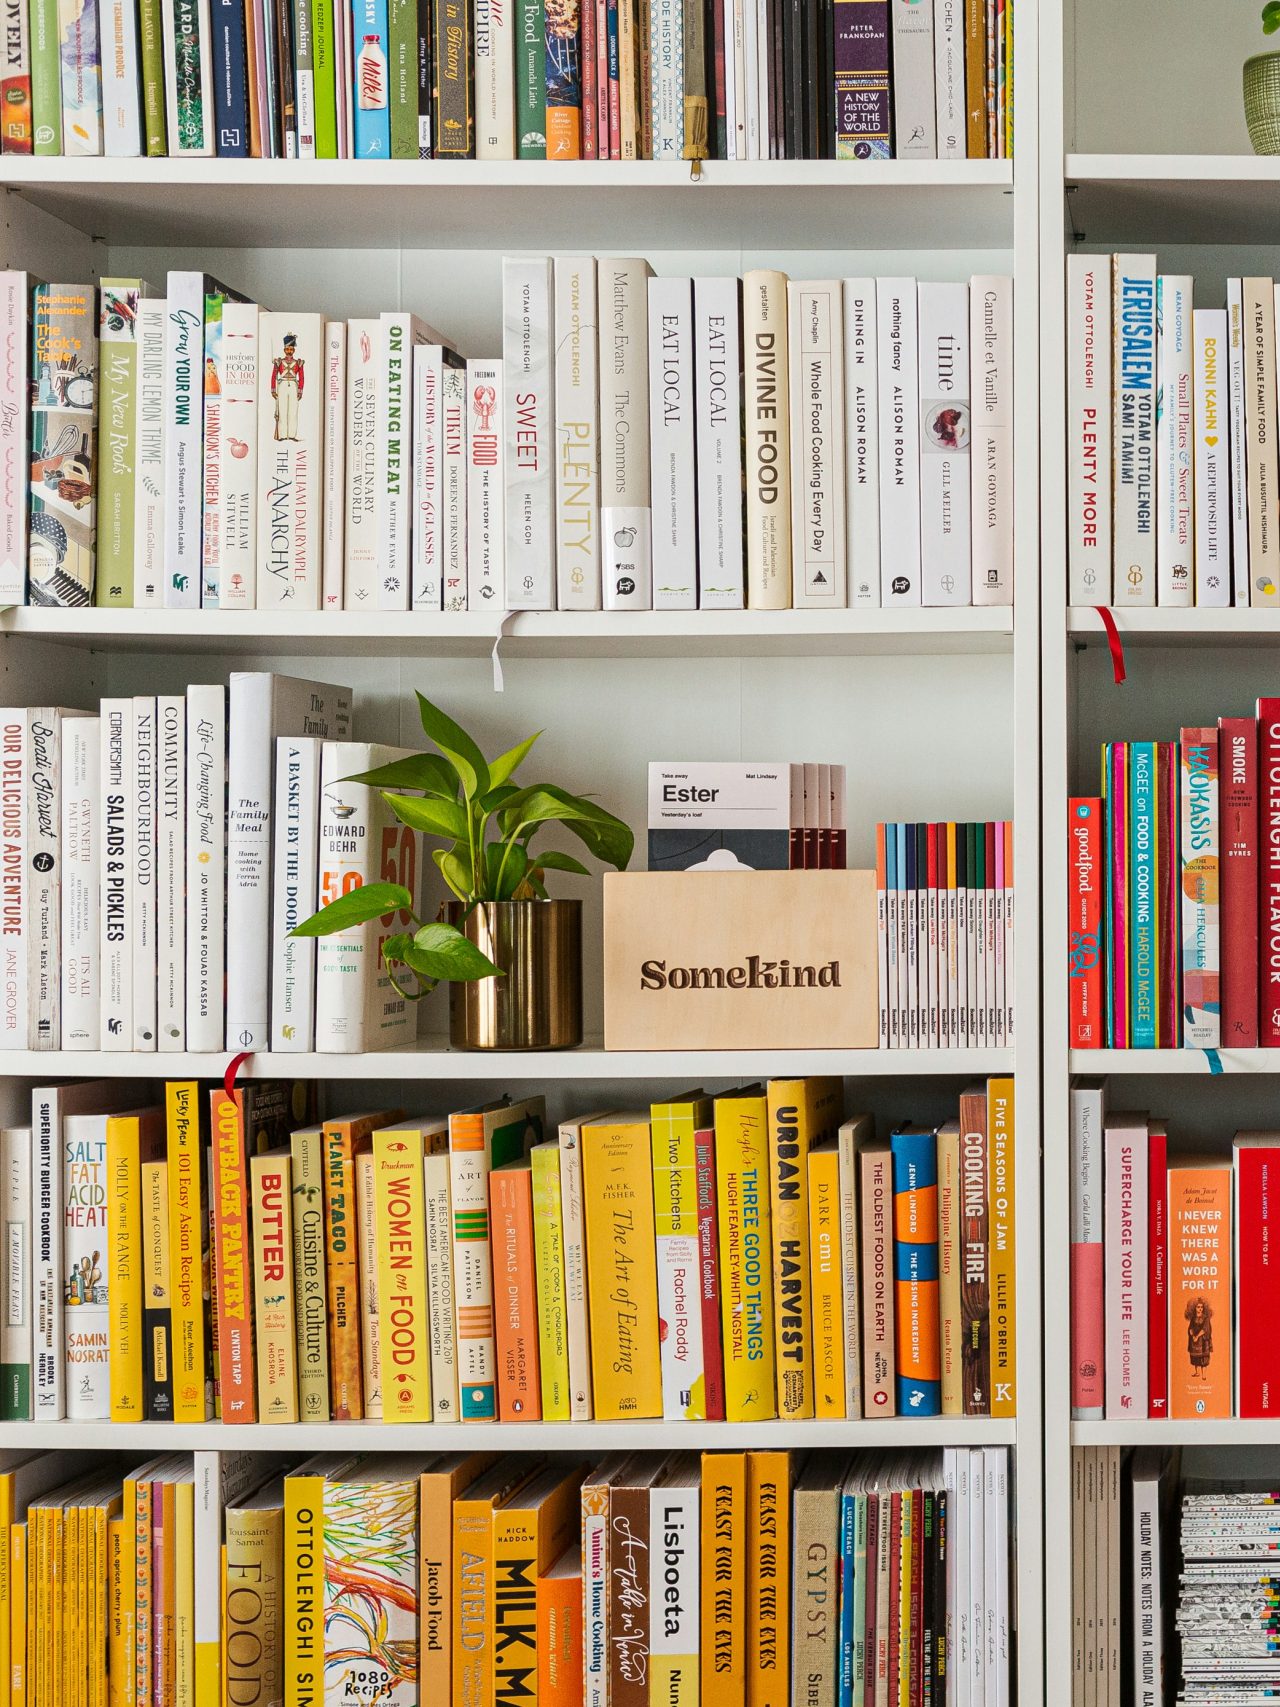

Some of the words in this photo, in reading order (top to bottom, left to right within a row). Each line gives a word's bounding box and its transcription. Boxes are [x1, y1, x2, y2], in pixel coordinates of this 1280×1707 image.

[525, 4, 536, 43] Food
[363, 57, 382, 102] Milk!
[528, 49, 536, 74] Amanda
[529, 79, 537, 108] Little
[844, 103, 880, 111] HISTORY
[845, 94, 852, 102] A
[856, 93, 879, 101] NEW
[844, 113, 857, 122] OF
[860, 113, 880, 121] THE
[844, 123, 880, 131] WORLD
[170, 310, 200, 354] Grow
[390, 326, 402, 351] ON
[663, 315, 679, 352] EAT
[1122, 278, 1152, 389] JERUSALEM
[176, 358, 190, 391] YOUR
[756, 334, 776, 419] DIVINE
[811, 361, 822, 399] Whole
[938, 336, 960, 390] time
[176, 396, 190, 424] OWN
[388, 359, 401, 432] EATING
[664, 362, 680, 426] LOCAL
[516, 394, 537, 471] SWEET
[812, 404, 822, 433] Food
[277, 450, 288, 473] THE
[810, 437, 823, 487] Cooking
[1084, 409, 1096, 483] PLENTY
[296, 450, 307, 508] WILLIAM
[388, 440, 400, 494] MEAT
[758, 430, 778, 504] FOOD
[563, 423, 591, 555] PLENTY
[811, 492, 823, 526] Every
[266, 477, 288, 580] ANARCHY
[1084, 493, 1096, 546] MORE
[295, 514, 306, 581] DALRYMPLE
[812, 530, 824, 552] Day
[4, 725, 22, 753] OUR
[165, 707, 177, 820] COMMUNITY
[1233, 737, 1245, 783] SMOKE
[3, 760, 22, 838] DELICIOUS
[138, 715, 150, 885] NEIGHBOURHOOD
[664, 785, 719, 802] Ester
[107, 796, 124, 855] SALADS
[231, 811, 269, 821] Family
[237, 824, 262, 832] Meal
[108, 862, 124, 872] &
[3, 844, 21, 936] ADVENTURE
[108, 878, 124, 941] PICKLES
[641, 955, 841, 990] Somekind
[40, 1104, 50, 1158] SUPERIORITY
[67, 1142, 107, 1162] SALT
[776, 1106, 800, 1200] URBAN
[41, 1162, 50, 1202] BURGER
[71, 1163, 101, 1184] FAT
[69, 1185, 104, 1206] ACID
[1122, 1148, 1132, 1245] SUPERCHARGE
[1179, 1211, 1181, 1220] I
[1185, 1211, 1222, 1220] NEVER
[41, 1207, 50, 1261] COOKBOOK
[65, 1207, 107, 1227] HEAT
[262, 1175, 284, 1281] BUTTER
[388, 1177, 412, 1269] WOMEN
[613, 1210, 634, 1244] The
[1183, 1225, 1218, 1234] KNEW
[1182, 1238, 1218, 1248] THERE
[1182, 1253, 1207, 1261] WAS
[1211, 1252, 1218, 1261] A
[396, 1274, 404, 1291] on
[615, 1249, 634, 1282] Art
[1122, 1251, 1132, 1287] YOUR
[1182, 1280, 1204, 1289] FOR
[1208, 1280, 1218, 1289] IT
[1183, 1266, 1217, 1275] WORD
[610, 1288, 632, 1310] of
[780, 1241, 803, 1362] HARVEST
[1122, 1294, 1132, 1320] LIFE
[390, 1296, 415, 1365] FOOD
[613, 1311, 637, 1374] Eating
[297, 1509, 313, 1658] OTTOLENGHI
[425, 1558, 442, 1606] Jacob
[664, 1507, 684, 1637] Lisboeta
[807, 1543, 827, 1643] GYPSY
[428, 1608, 442, 1650] Food
